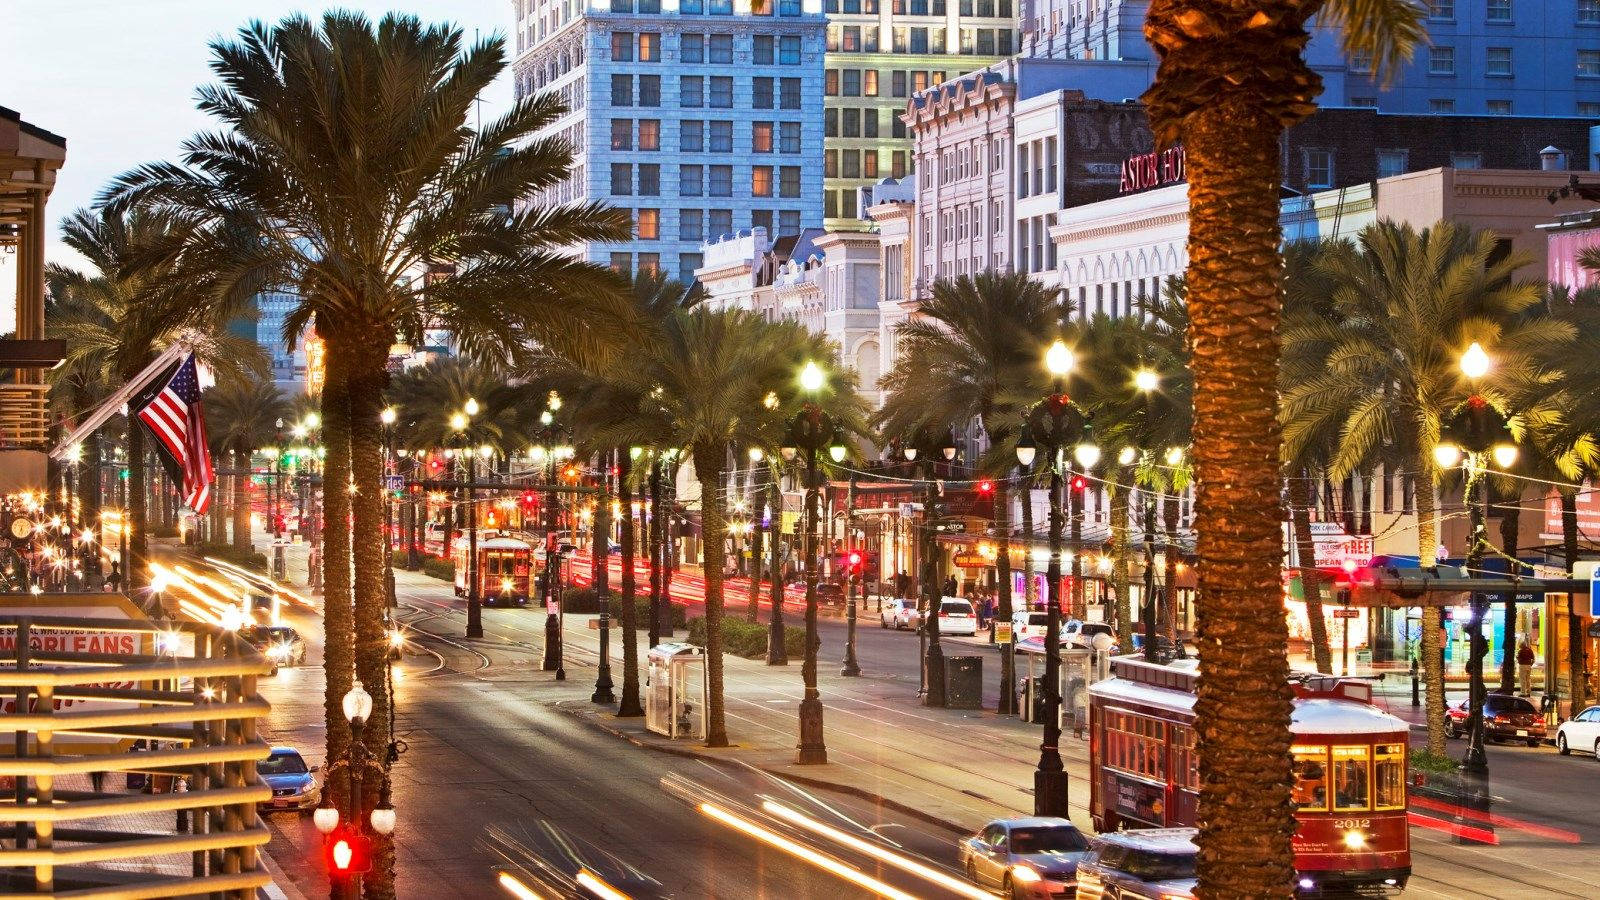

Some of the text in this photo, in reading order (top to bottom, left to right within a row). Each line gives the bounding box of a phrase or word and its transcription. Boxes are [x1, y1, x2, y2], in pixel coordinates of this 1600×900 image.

[1120, 153, 1159, 192] ASTOR
[1344, 540, 1370, 554] FREE
[1334, 819, 1371, 829] 2012
